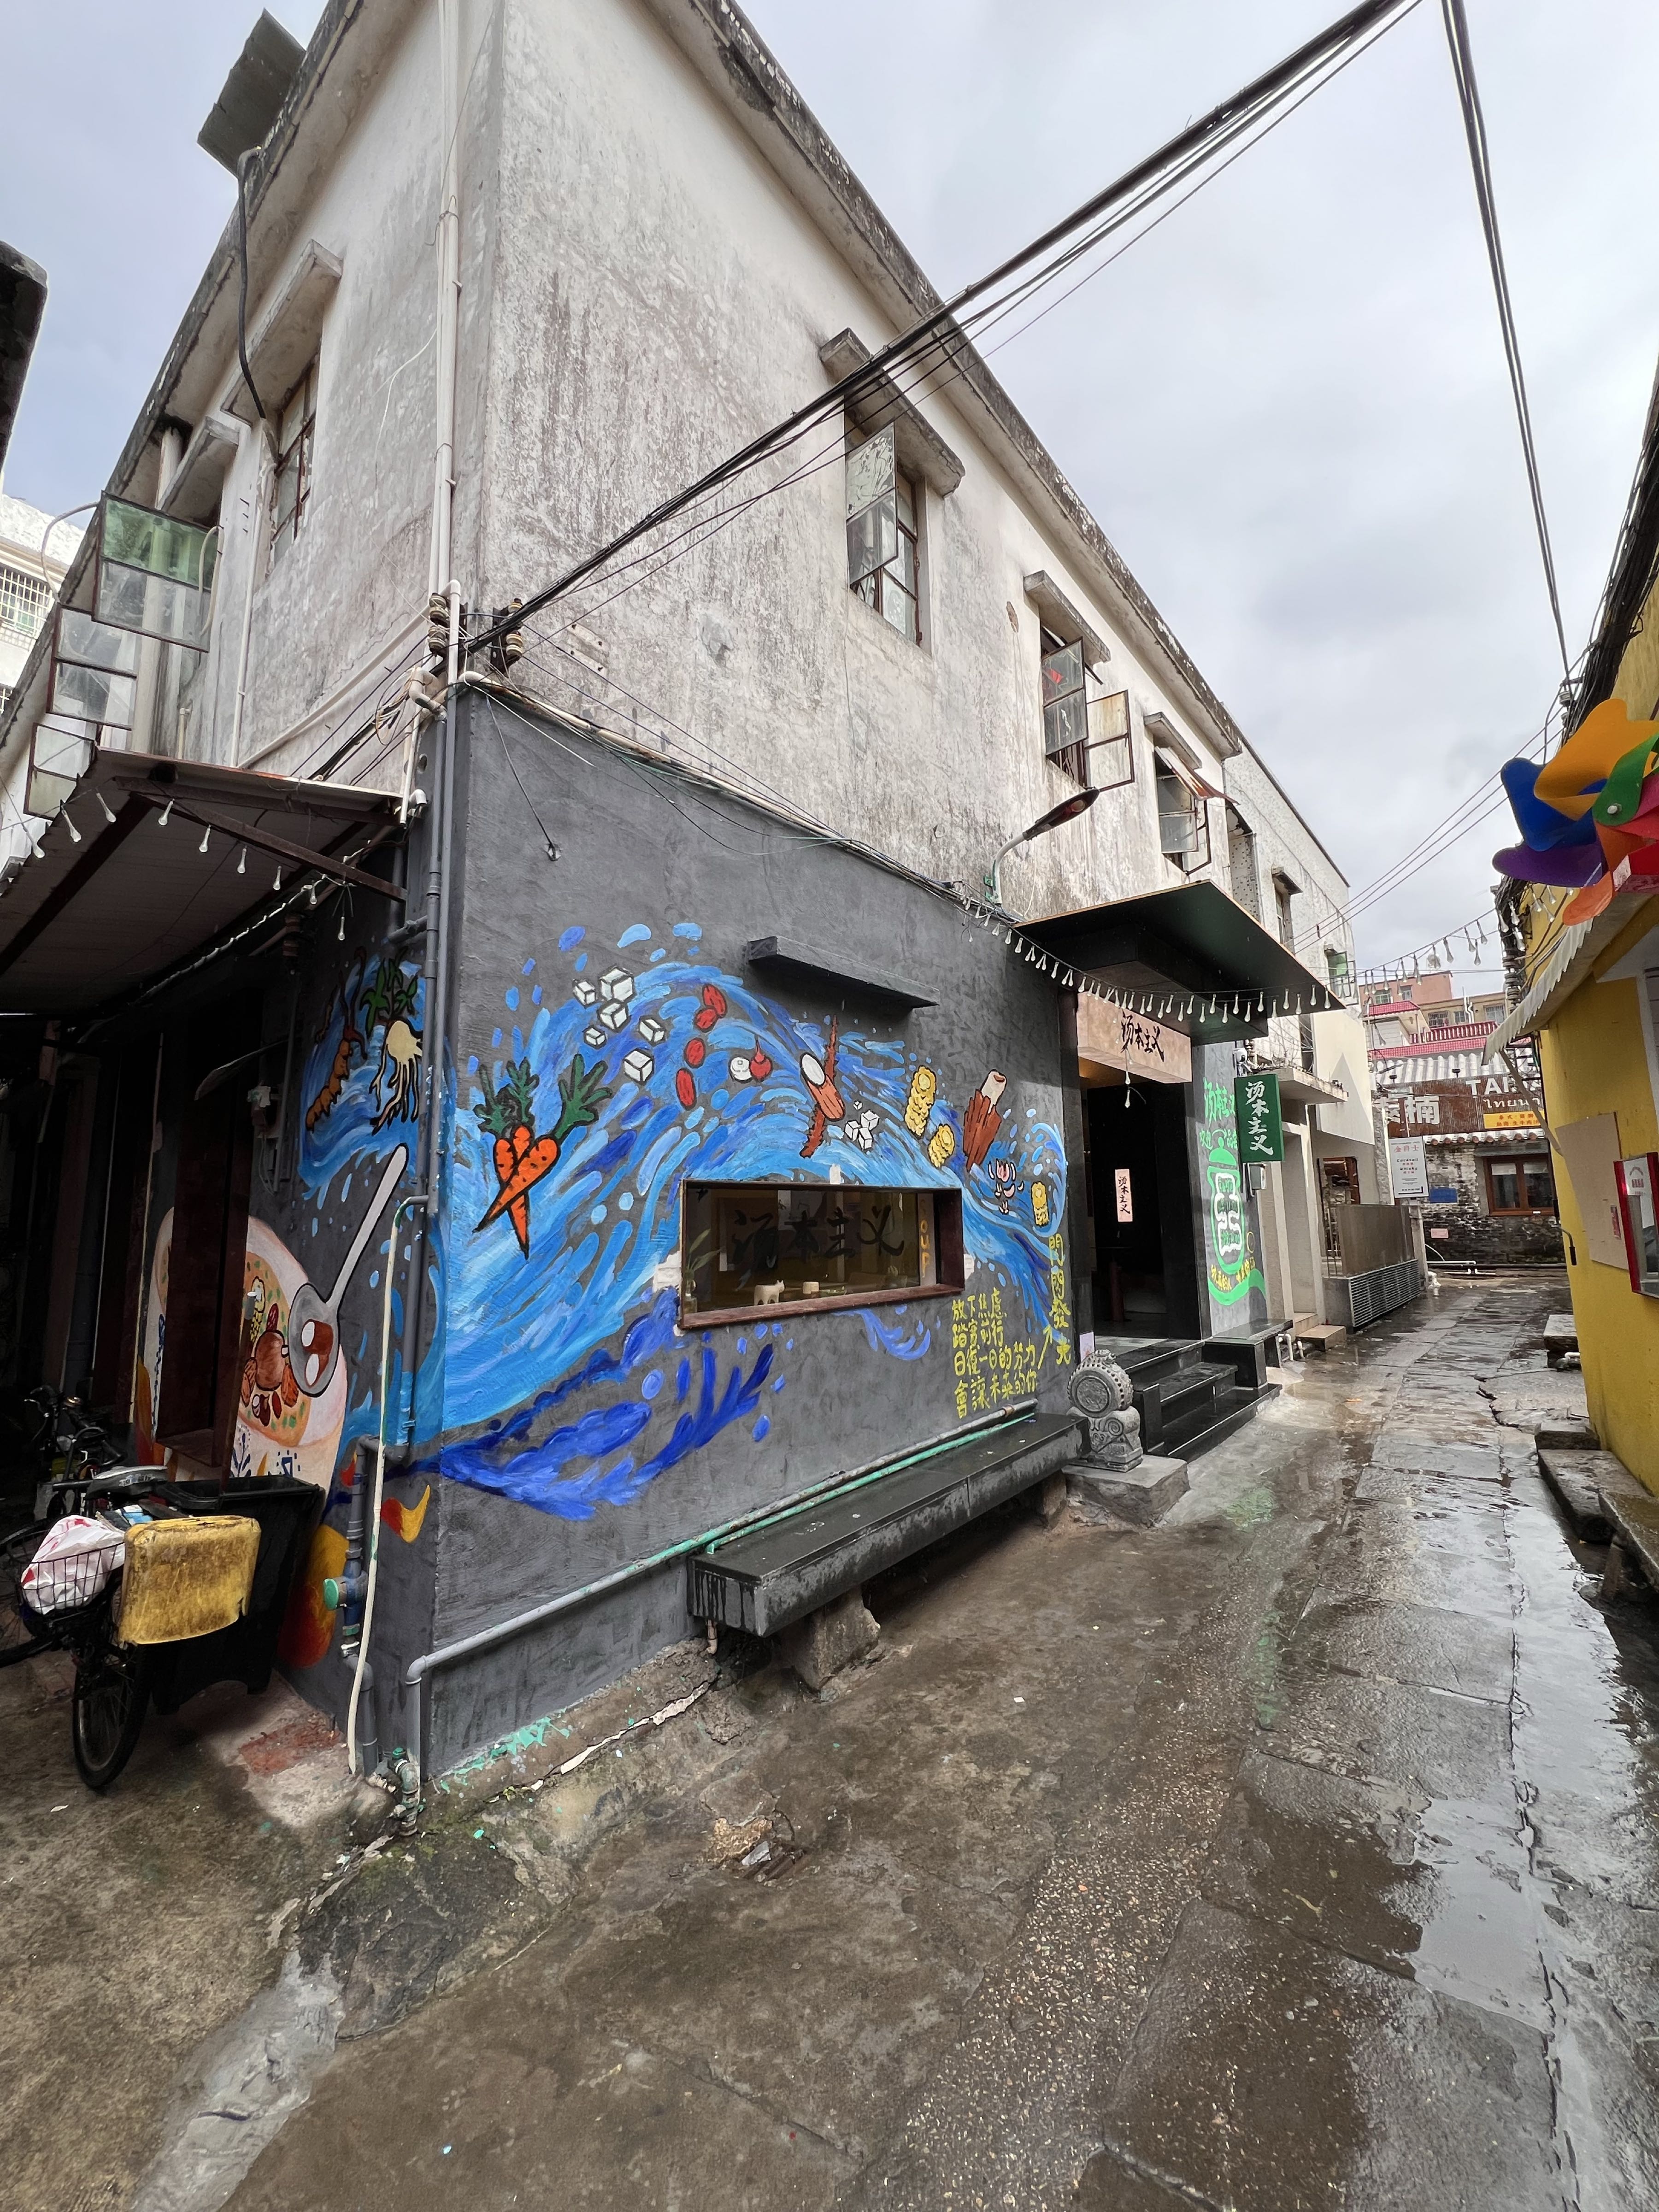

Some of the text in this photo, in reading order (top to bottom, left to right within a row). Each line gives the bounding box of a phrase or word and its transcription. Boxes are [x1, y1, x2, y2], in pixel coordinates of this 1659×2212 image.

[1120, 1009, 1165, 1062] 汤本主义
[1245, 1081, 1274, 1155] 汤本主义
[1118, 1176, 1130, 1214] 汤本主义
